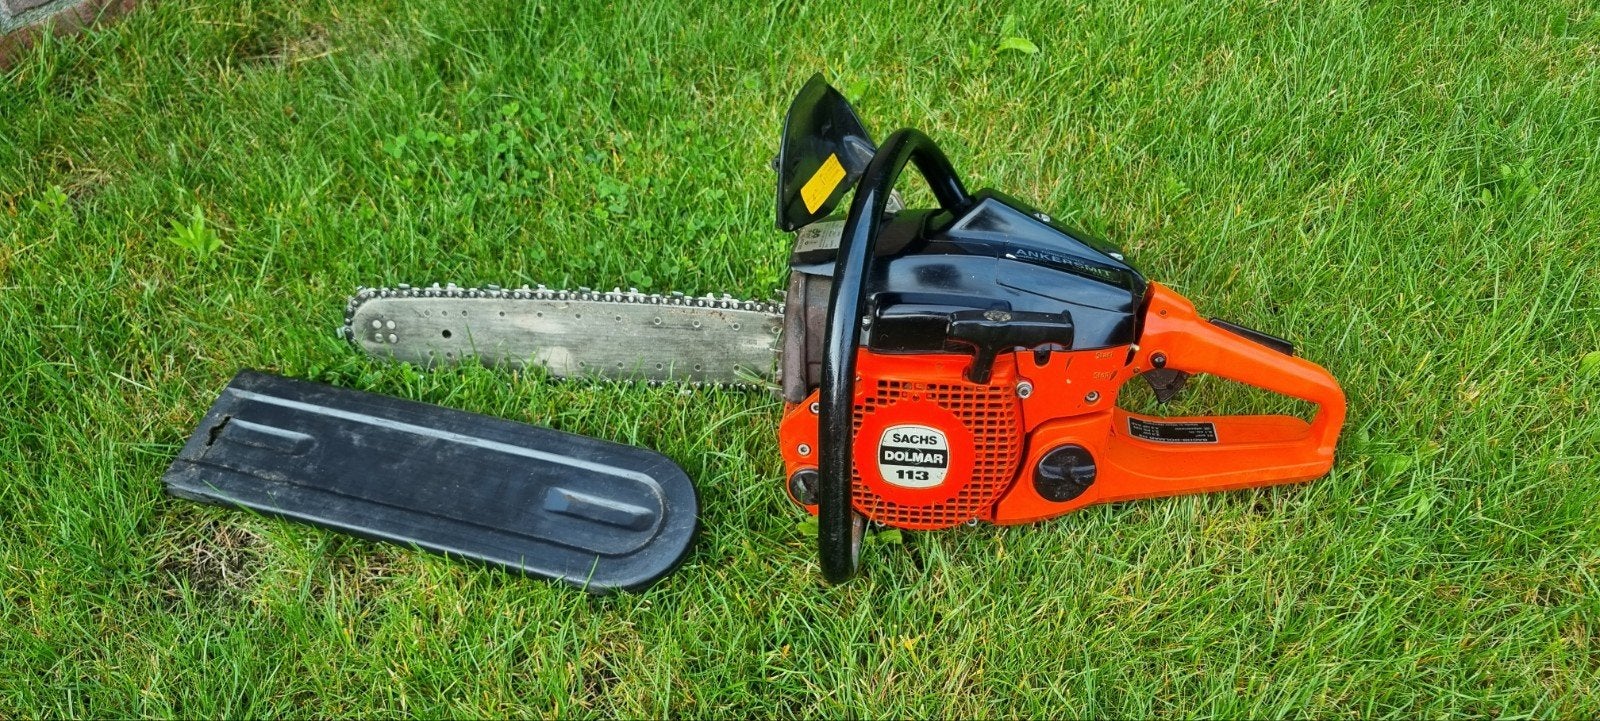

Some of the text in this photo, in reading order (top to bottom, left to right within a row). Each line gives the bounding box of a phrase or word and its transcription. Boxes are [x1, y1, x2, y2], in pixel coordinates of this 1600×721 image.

[1016, 248, 1111, 277] ANKERSMIT
[892, 433, 938, 445] SACHS
[884, 450, 943, 464] DOLMAR
[896, 469, 929, 480] 113
